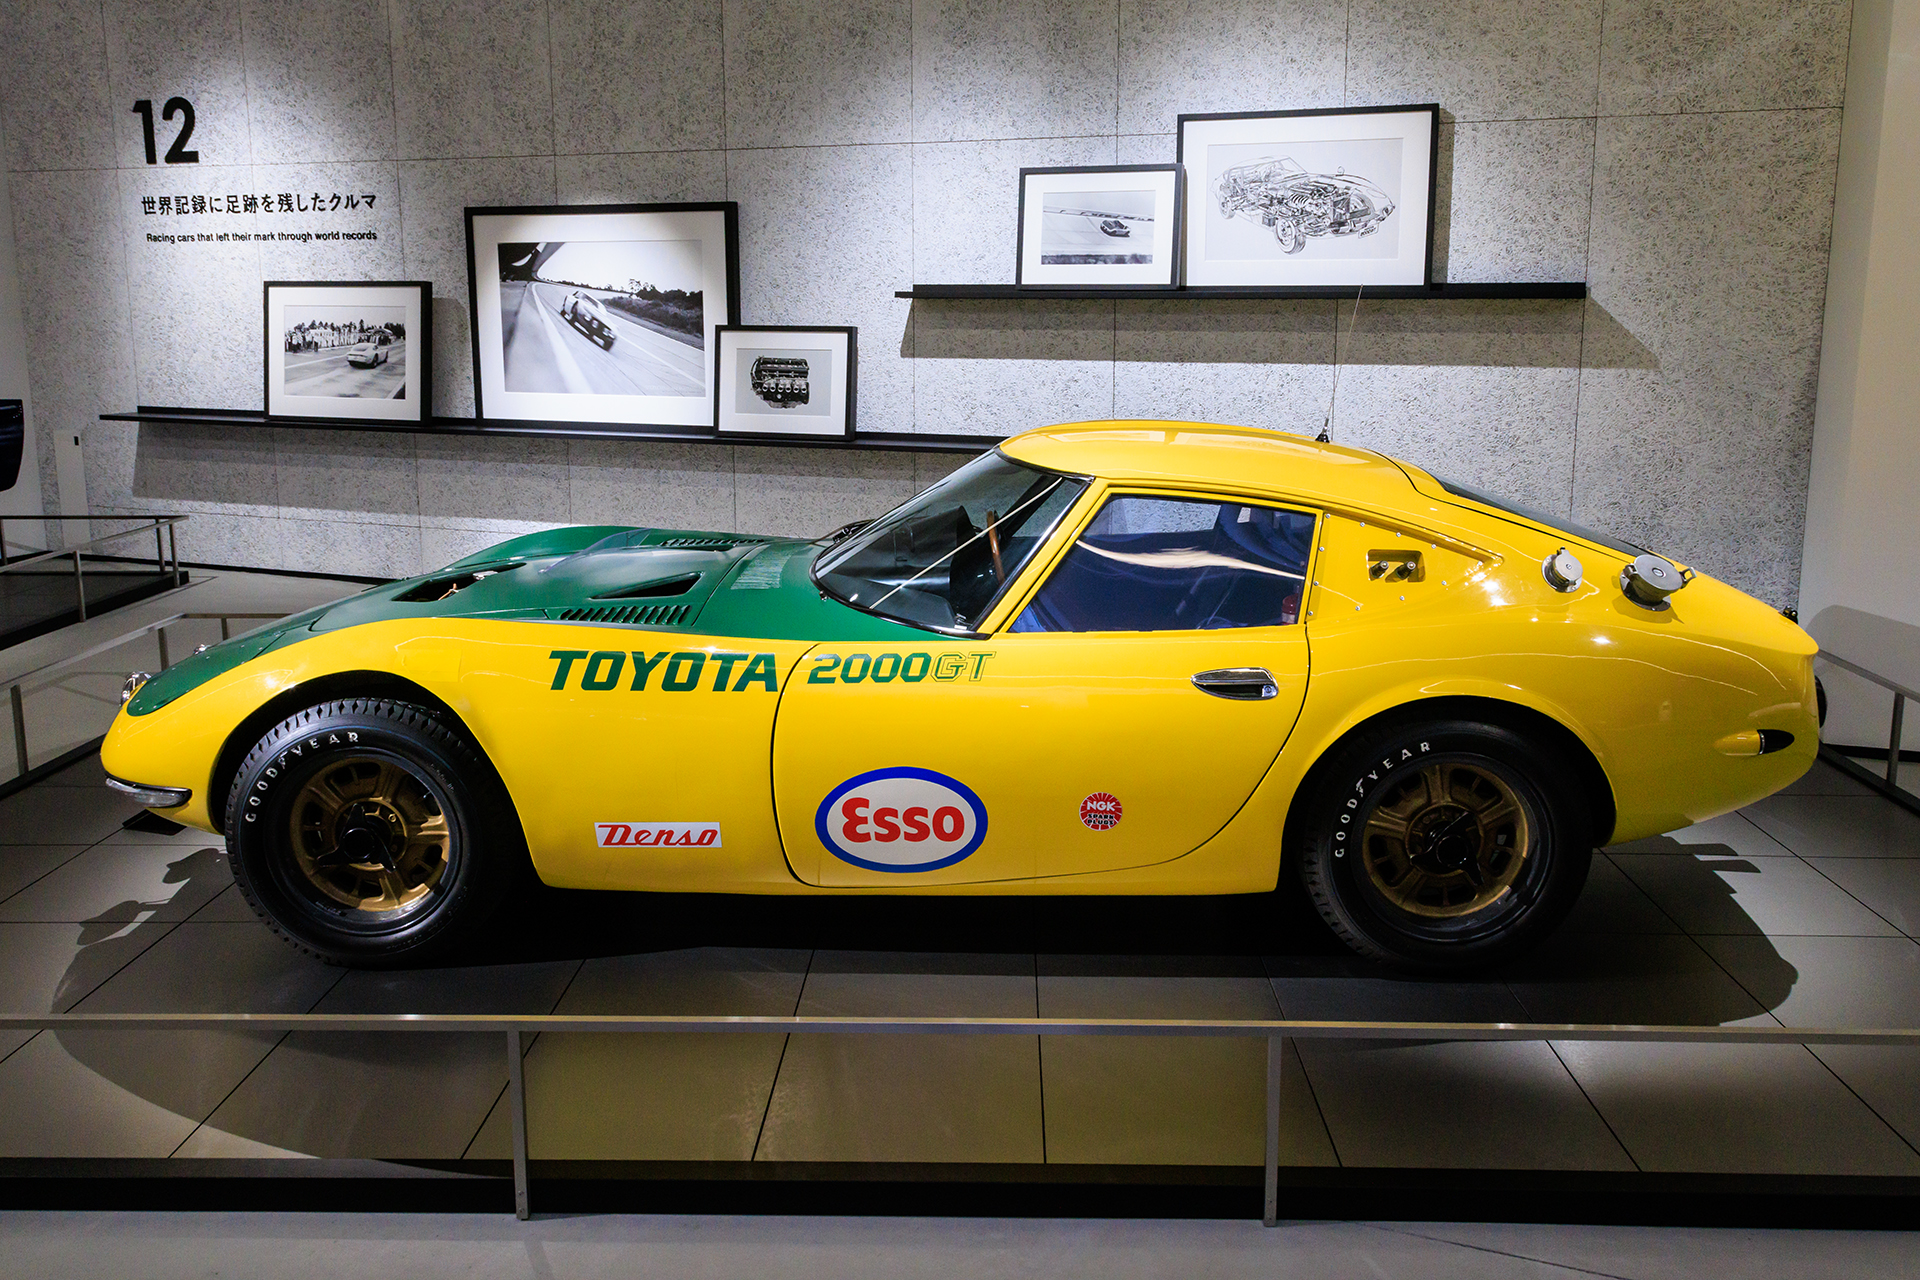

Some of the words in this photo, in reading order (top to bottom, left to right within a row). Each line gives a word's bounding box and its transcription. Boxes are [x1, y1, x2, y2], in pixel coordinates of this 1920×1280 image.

[132, 96, 200, 165] 12
[141, 192, 377, 216] 世界記録に足跡を残したクルマ
[146, 233, 175, 245] Racing
[177, 233, 195, 242] cars
[197, 232, 214, 242] that
[216, 232, 230, 242] left
[232, 232, 252, 242] their
[254, 232, 275, 241] mark
[278, 232, 312, 243] through
[315, 231, 340, 241] world
[342, 230, 378, 241] records
[549, 650, 778, 692] TOYOTA
[807, 651, 997, 684] 2000GT
[1087, 801, 1116, 811] NGK
[841, 797, 965, 843] Esso
[598, 824, 718, 846] Denso
